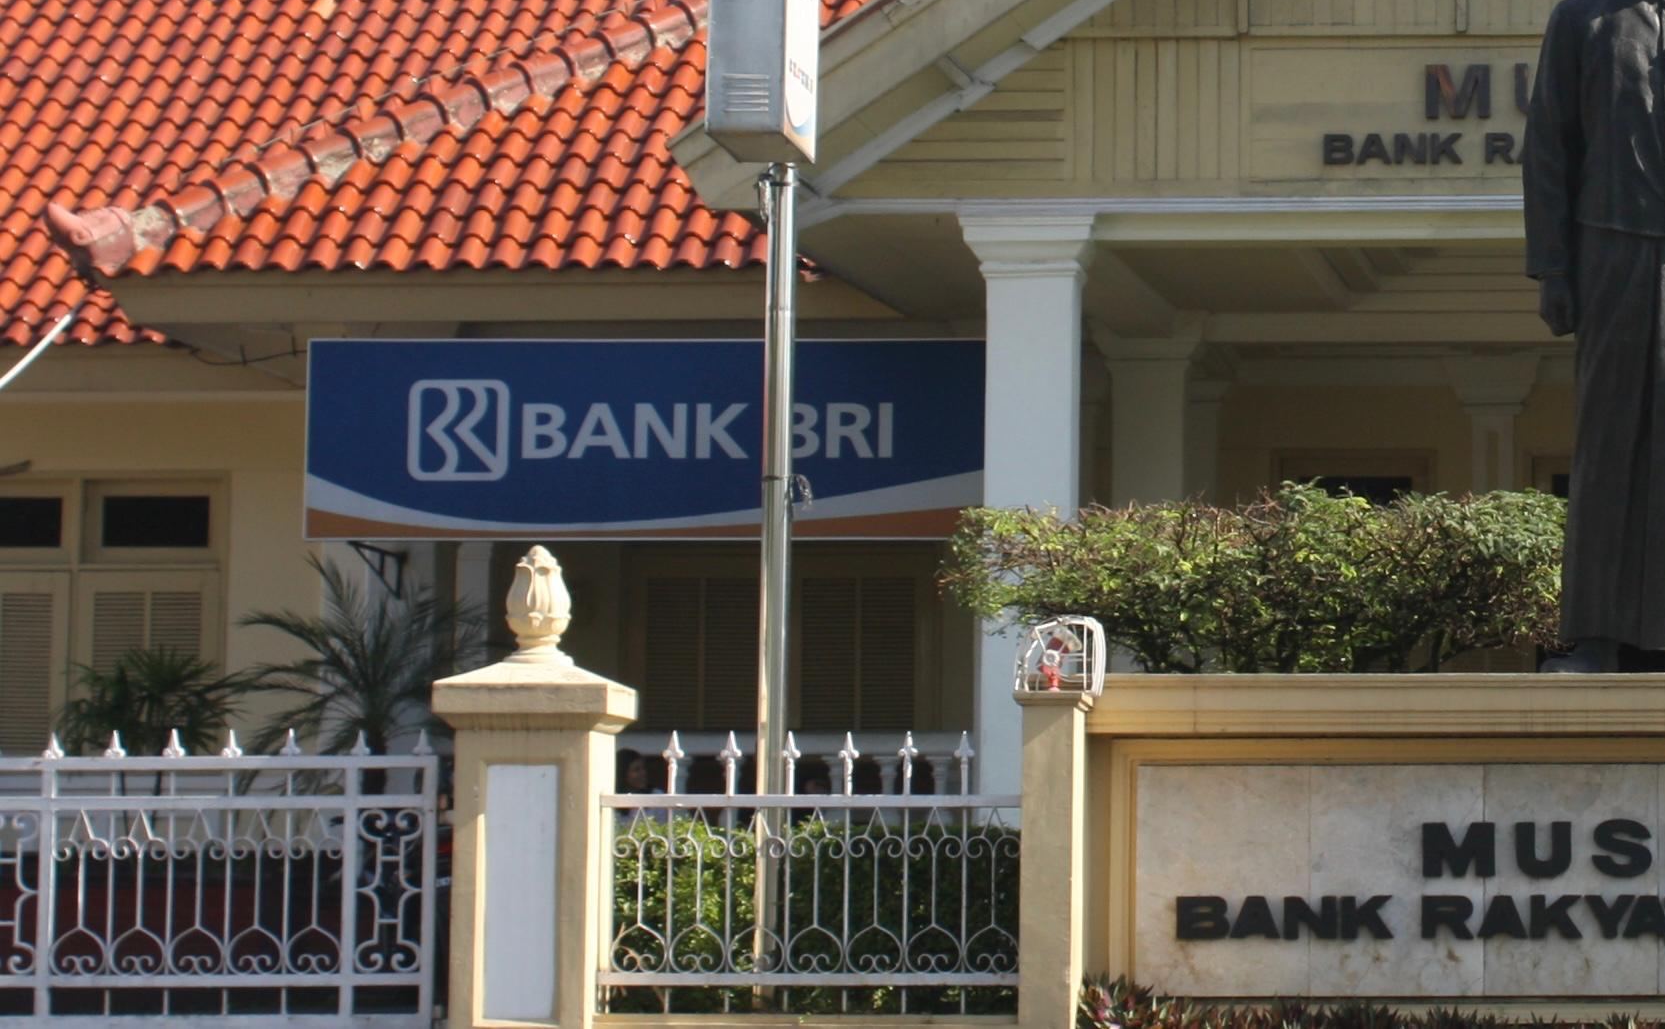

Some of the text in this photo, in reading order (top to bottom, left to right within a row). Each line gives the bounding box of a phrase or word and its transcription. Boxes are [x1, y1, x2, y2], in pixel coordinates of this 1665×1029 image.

[1323, 132, 1464, 165] BANK
[521, 402, 749, 459] BANK
[1175, 894, 1395, 941] BANK
